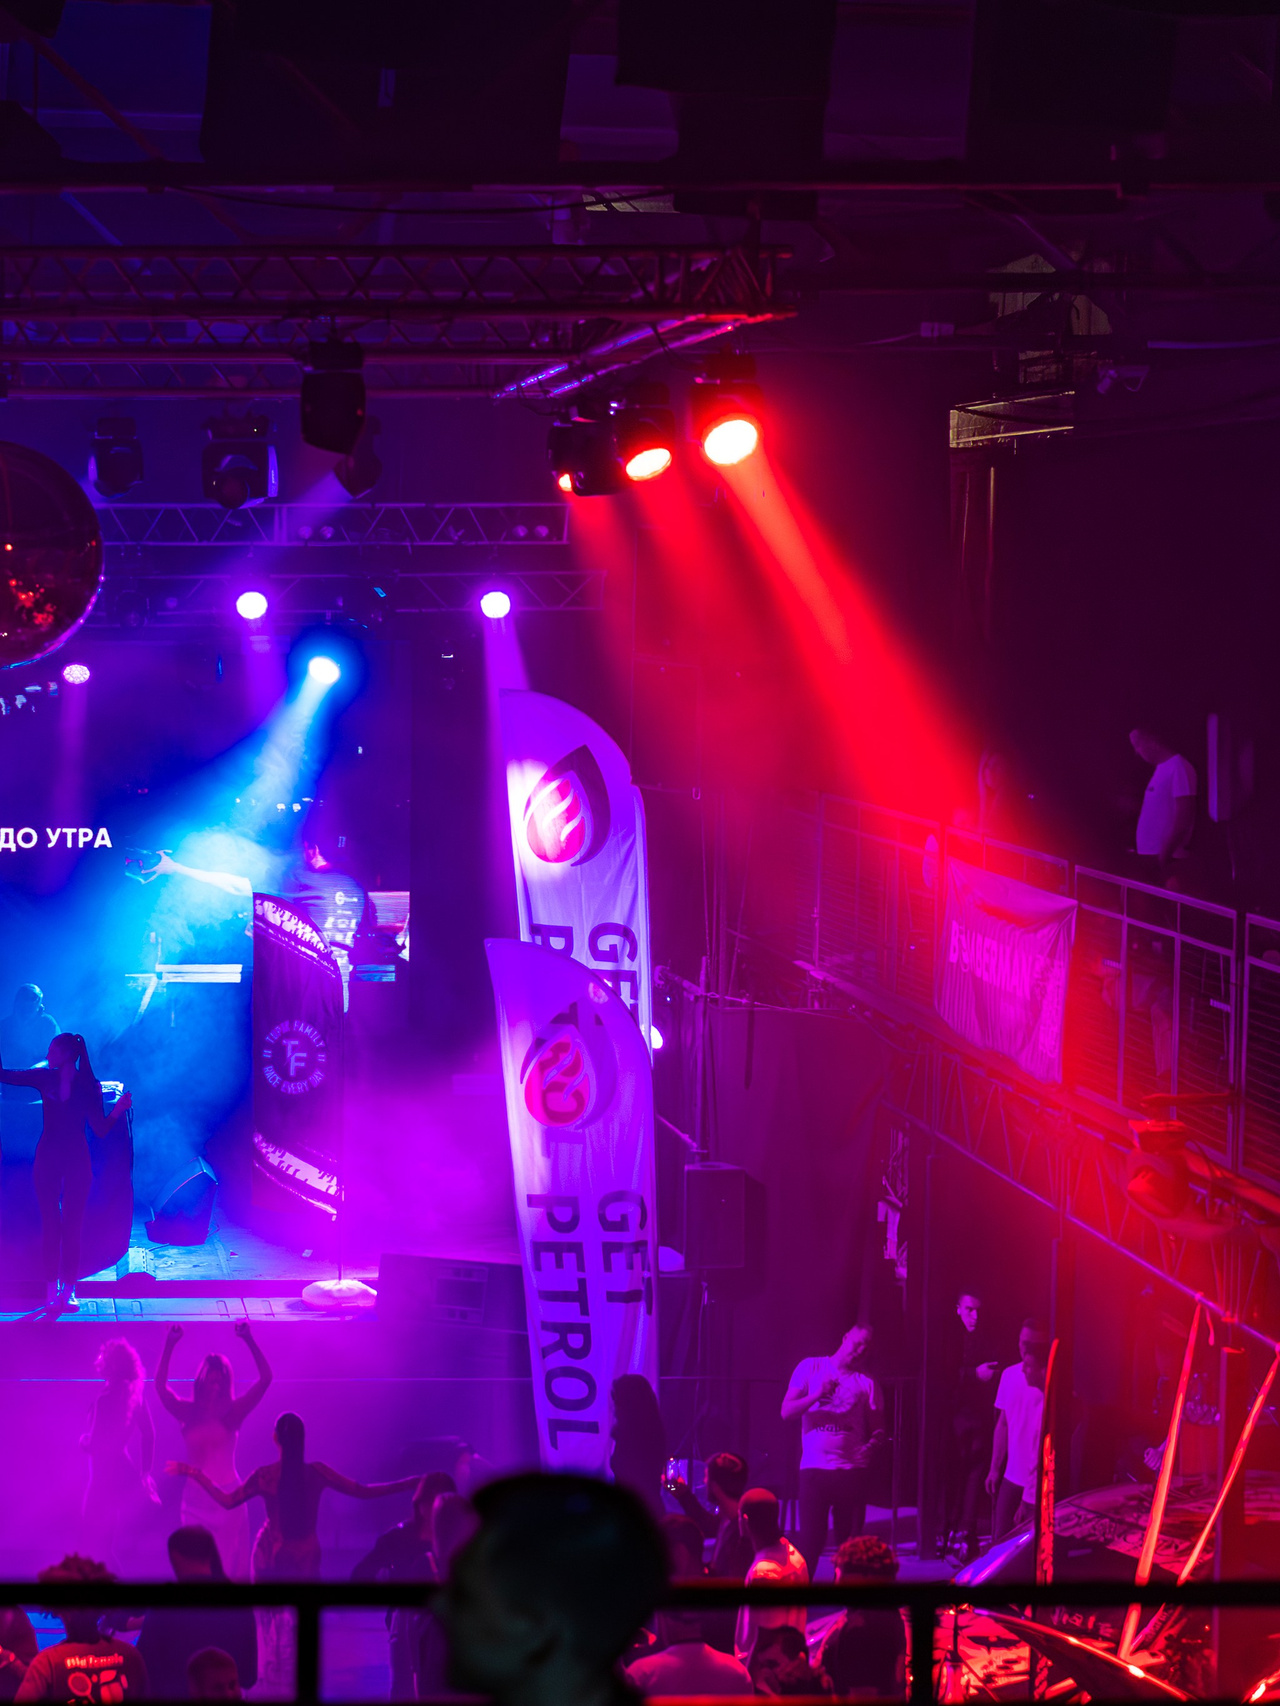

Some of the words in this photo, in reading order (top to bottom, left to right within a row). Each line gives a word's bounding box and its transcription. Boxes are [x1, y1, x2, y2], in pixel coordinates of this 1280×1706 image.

[46, 827, 113, 848] УТРА
[293, 1020, 326, 1047] FAMILY
[282, 1040, 307, 1077] TF
[280, 1080, 309, 1094] EVERY
[597, 1190, 653, 1317] GET
[527, 1193, 599, 1451] PETROL
